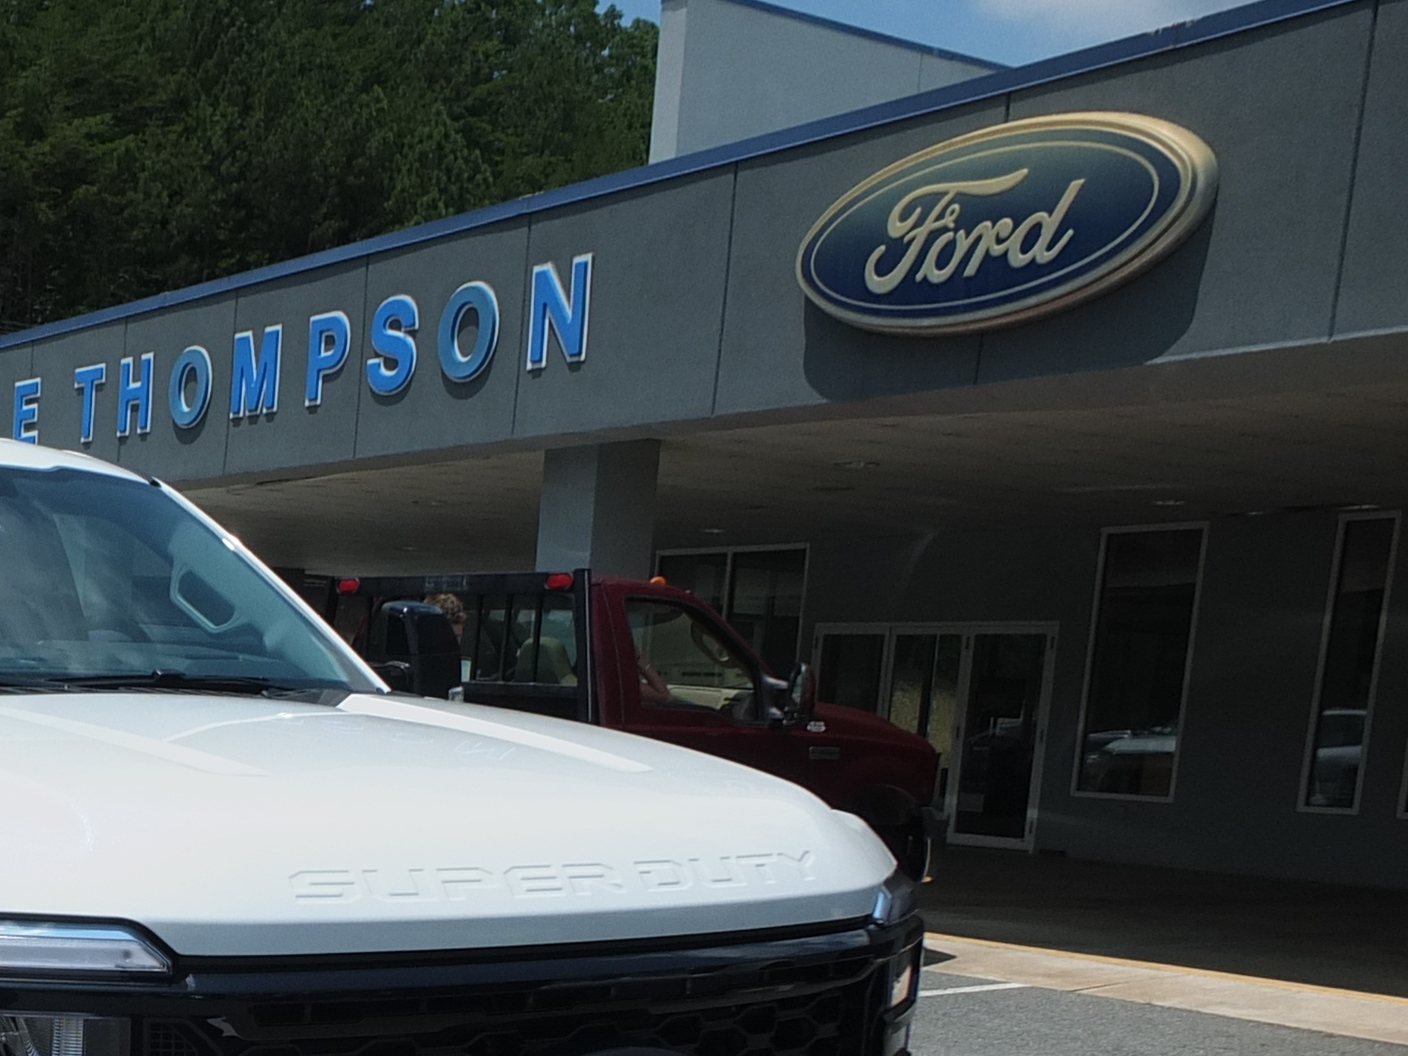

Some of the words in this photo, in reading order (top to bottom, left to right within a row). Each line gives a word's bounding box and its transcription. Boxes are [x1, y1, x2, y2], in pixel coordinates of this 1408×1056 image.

[864, 168, 1086, 294] Ford
[73, 253, 594, 444] THOMPSON
[289, 862, 627, 905] SUPER
[633, 850, 817, 896] DUTY
